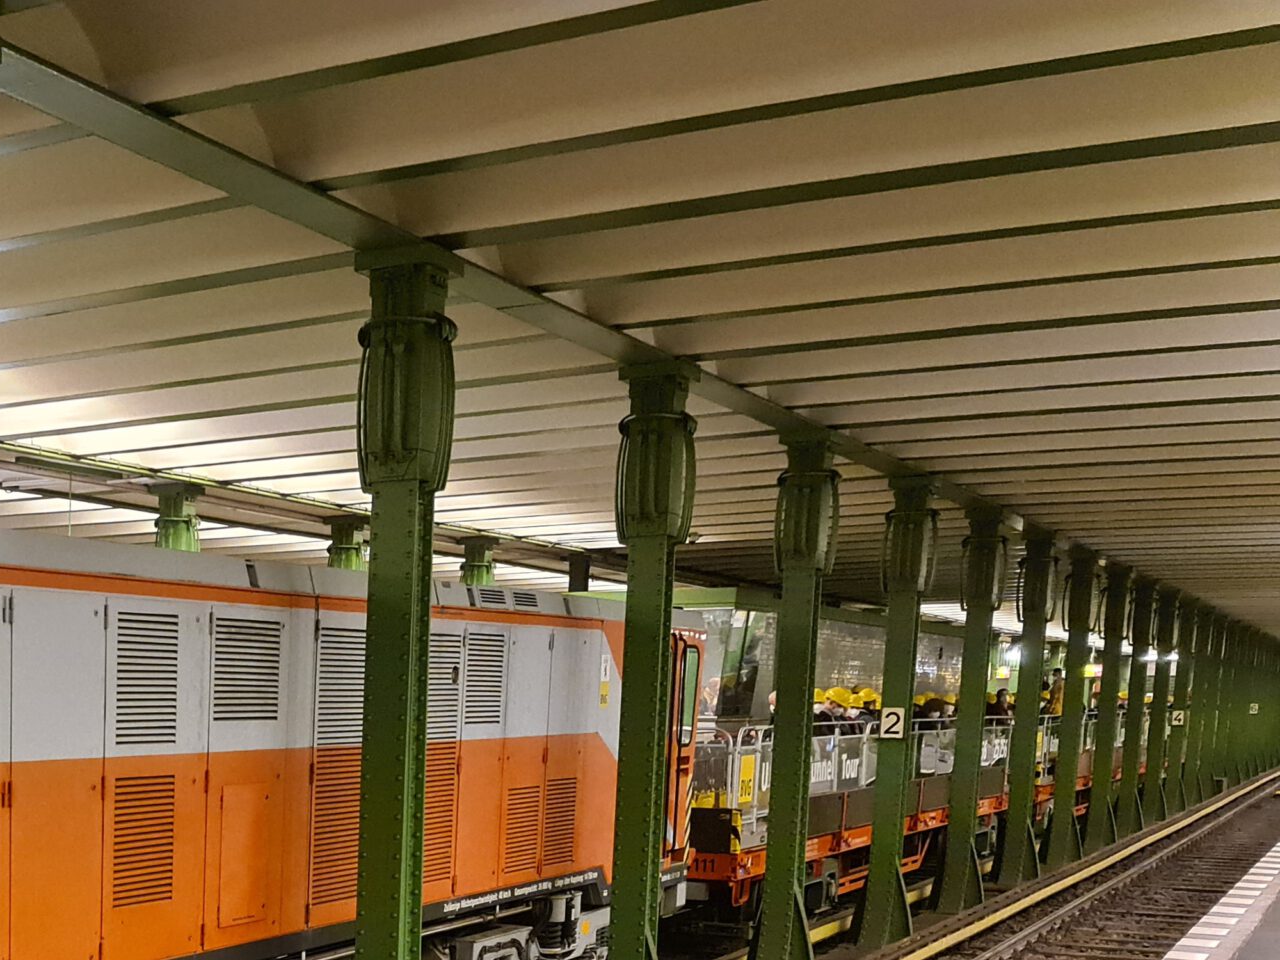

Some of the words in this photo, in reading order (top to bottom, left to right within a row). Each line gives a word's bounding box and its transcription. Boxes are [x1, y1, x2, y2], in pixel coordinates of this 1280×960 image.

[883, 711, 901, 735] 2
[1173, 712, 1182, 724] 4
[810, 755, 835, 783] unnel
[841, 753, 860, 780] Tour
